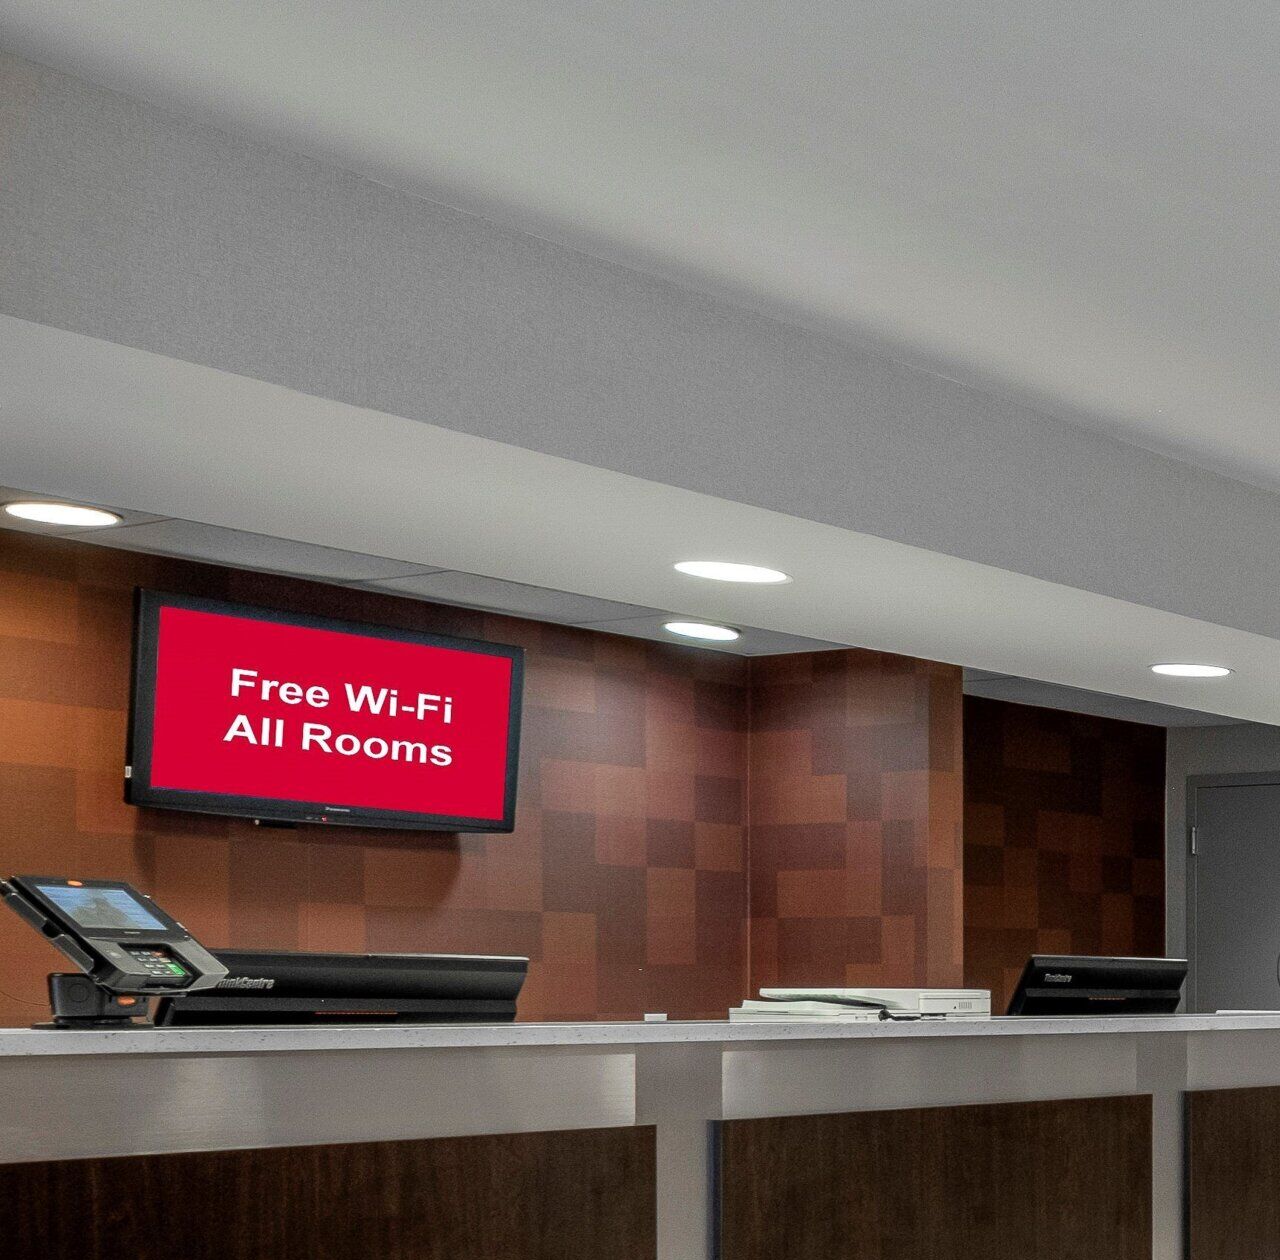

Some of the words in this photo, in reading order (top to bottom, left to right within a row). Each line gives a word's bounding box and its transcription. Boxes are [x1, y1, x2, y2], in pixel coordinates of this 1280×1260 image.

[231, 668, 330, 708] Free
[344, 683, 453, 724] Wi-Fi
[223, 714, 284, 747] All
[301, 722, 453, 767] Rooms
